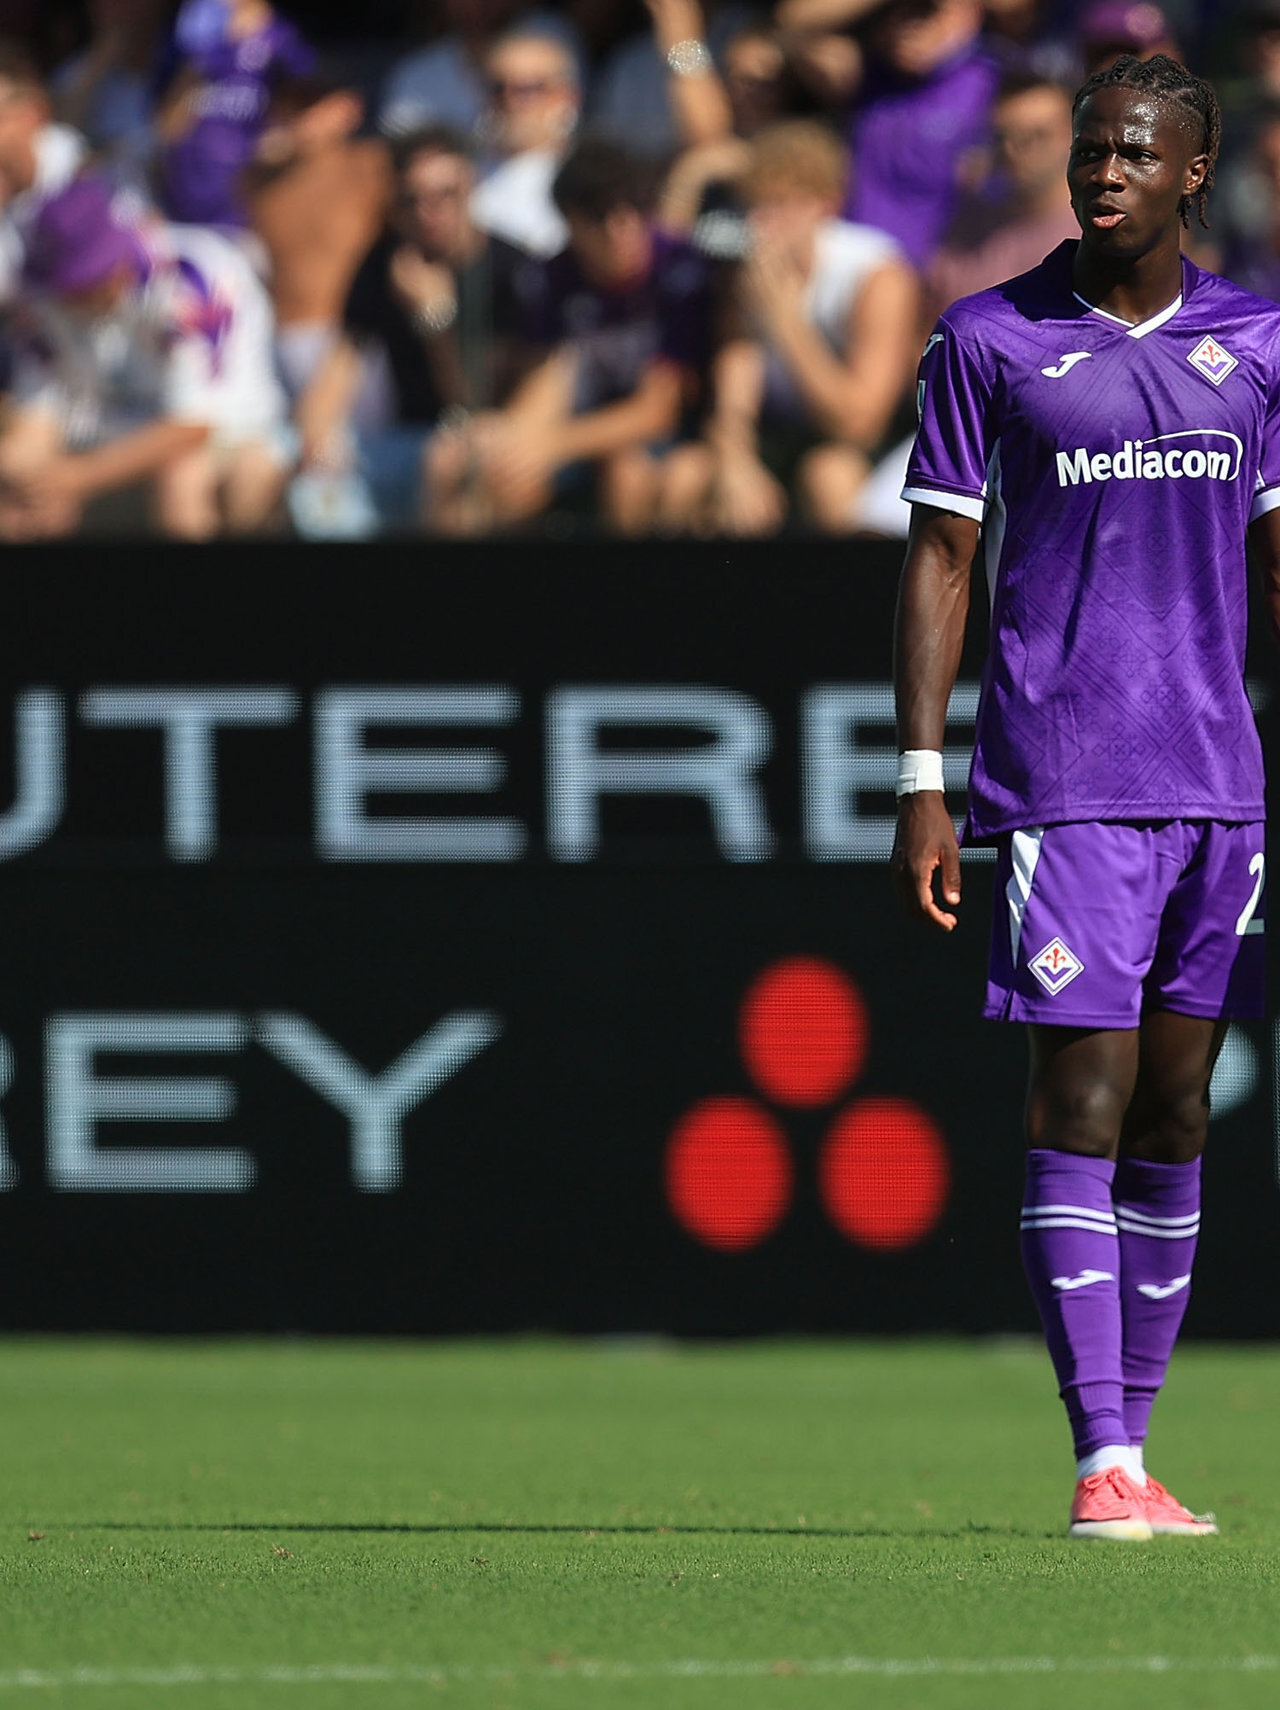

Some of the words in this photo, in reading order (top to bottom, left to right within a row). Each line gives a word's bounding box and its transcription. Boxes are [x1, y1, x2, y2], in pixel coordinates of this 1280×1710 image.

[1055, 431, 1243, 488] Mediacom
[0, 684, 1276, 863] TERE
[0, 1010, 504, 1193] EY
